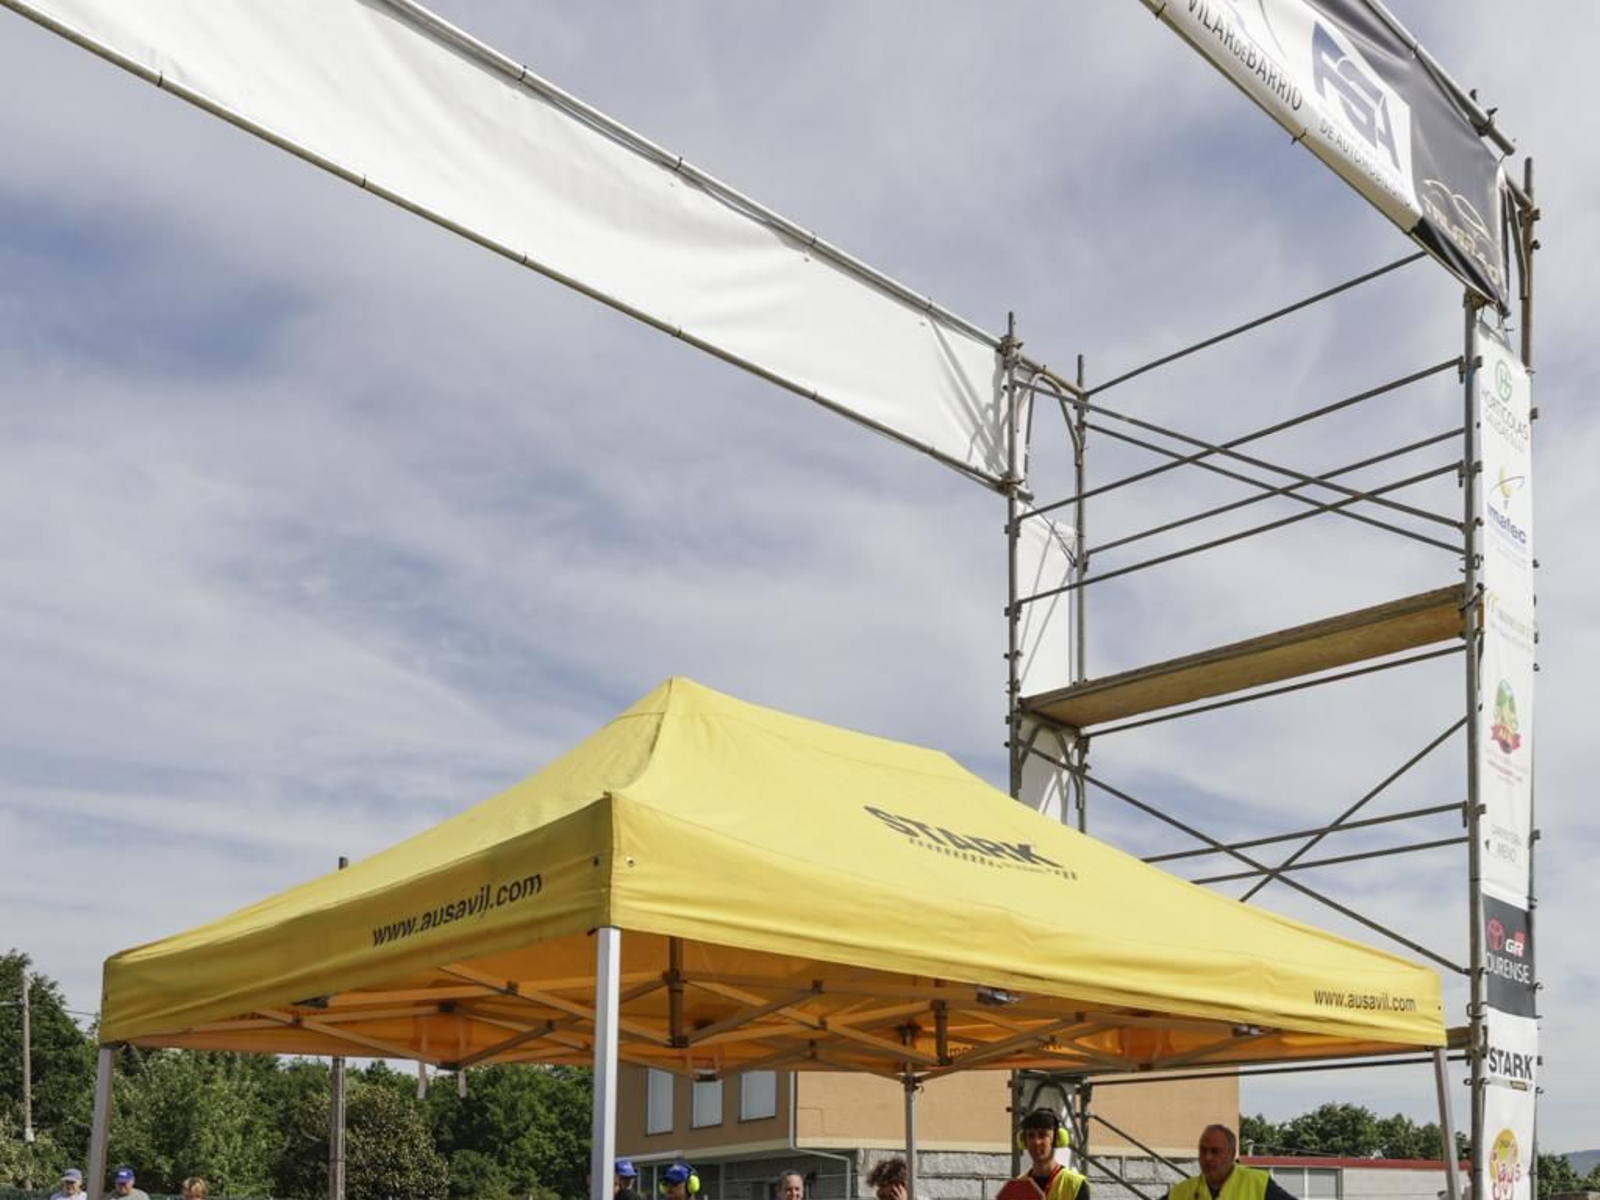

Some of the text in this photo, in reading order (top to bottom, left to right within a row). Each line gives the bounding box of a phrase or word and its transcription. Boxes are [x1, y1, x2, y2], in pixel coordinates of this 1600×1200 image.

[372, 874, 543, 947] www.ausavil.com
[1486, 952, 1530, 984] OURENSE
[1313, 990, 1417, 1013] www.ausavil.com
[1489, 1047, 1533, 1080] STARK
